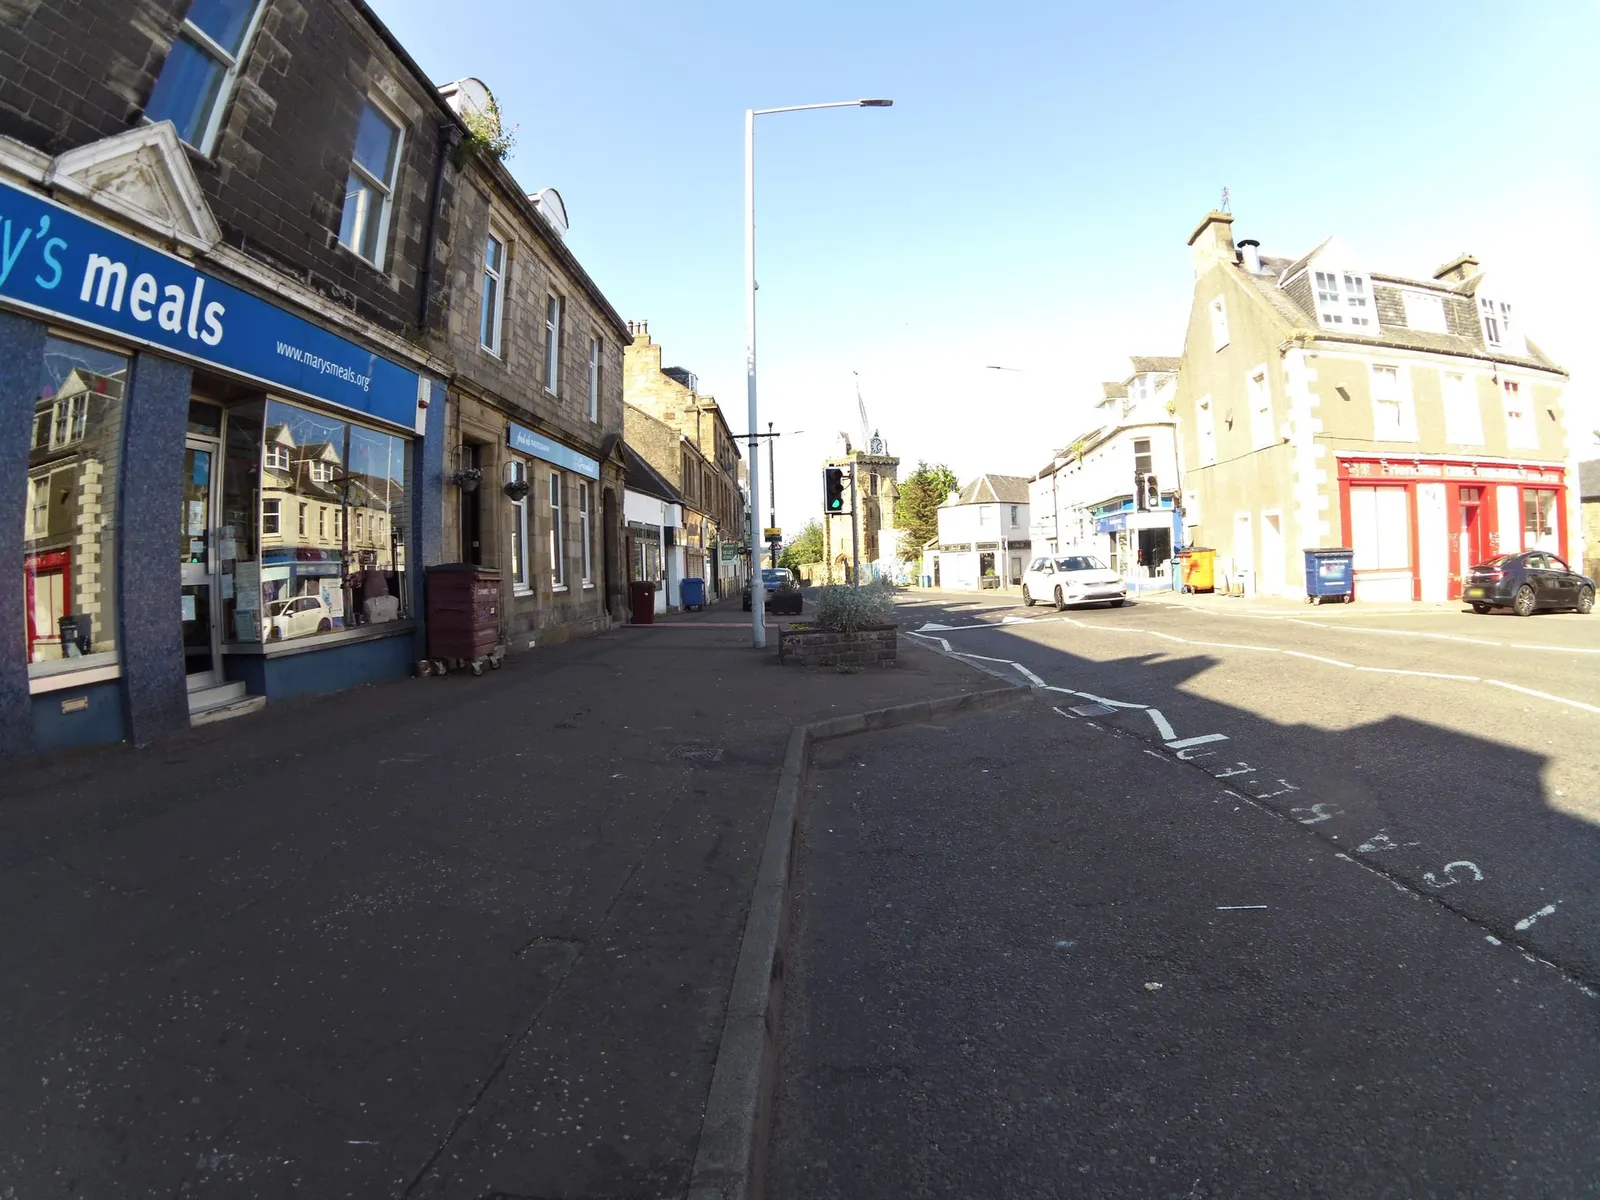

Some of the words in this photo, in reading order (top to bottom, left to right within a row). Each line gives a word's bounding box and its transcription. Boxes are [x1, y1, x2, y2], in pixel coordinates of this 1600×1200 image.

[0, 214, 68, 290] y's
[80, 253, 225, 346] meals
[276, 340, 370, 392] www.marysmeals.org
